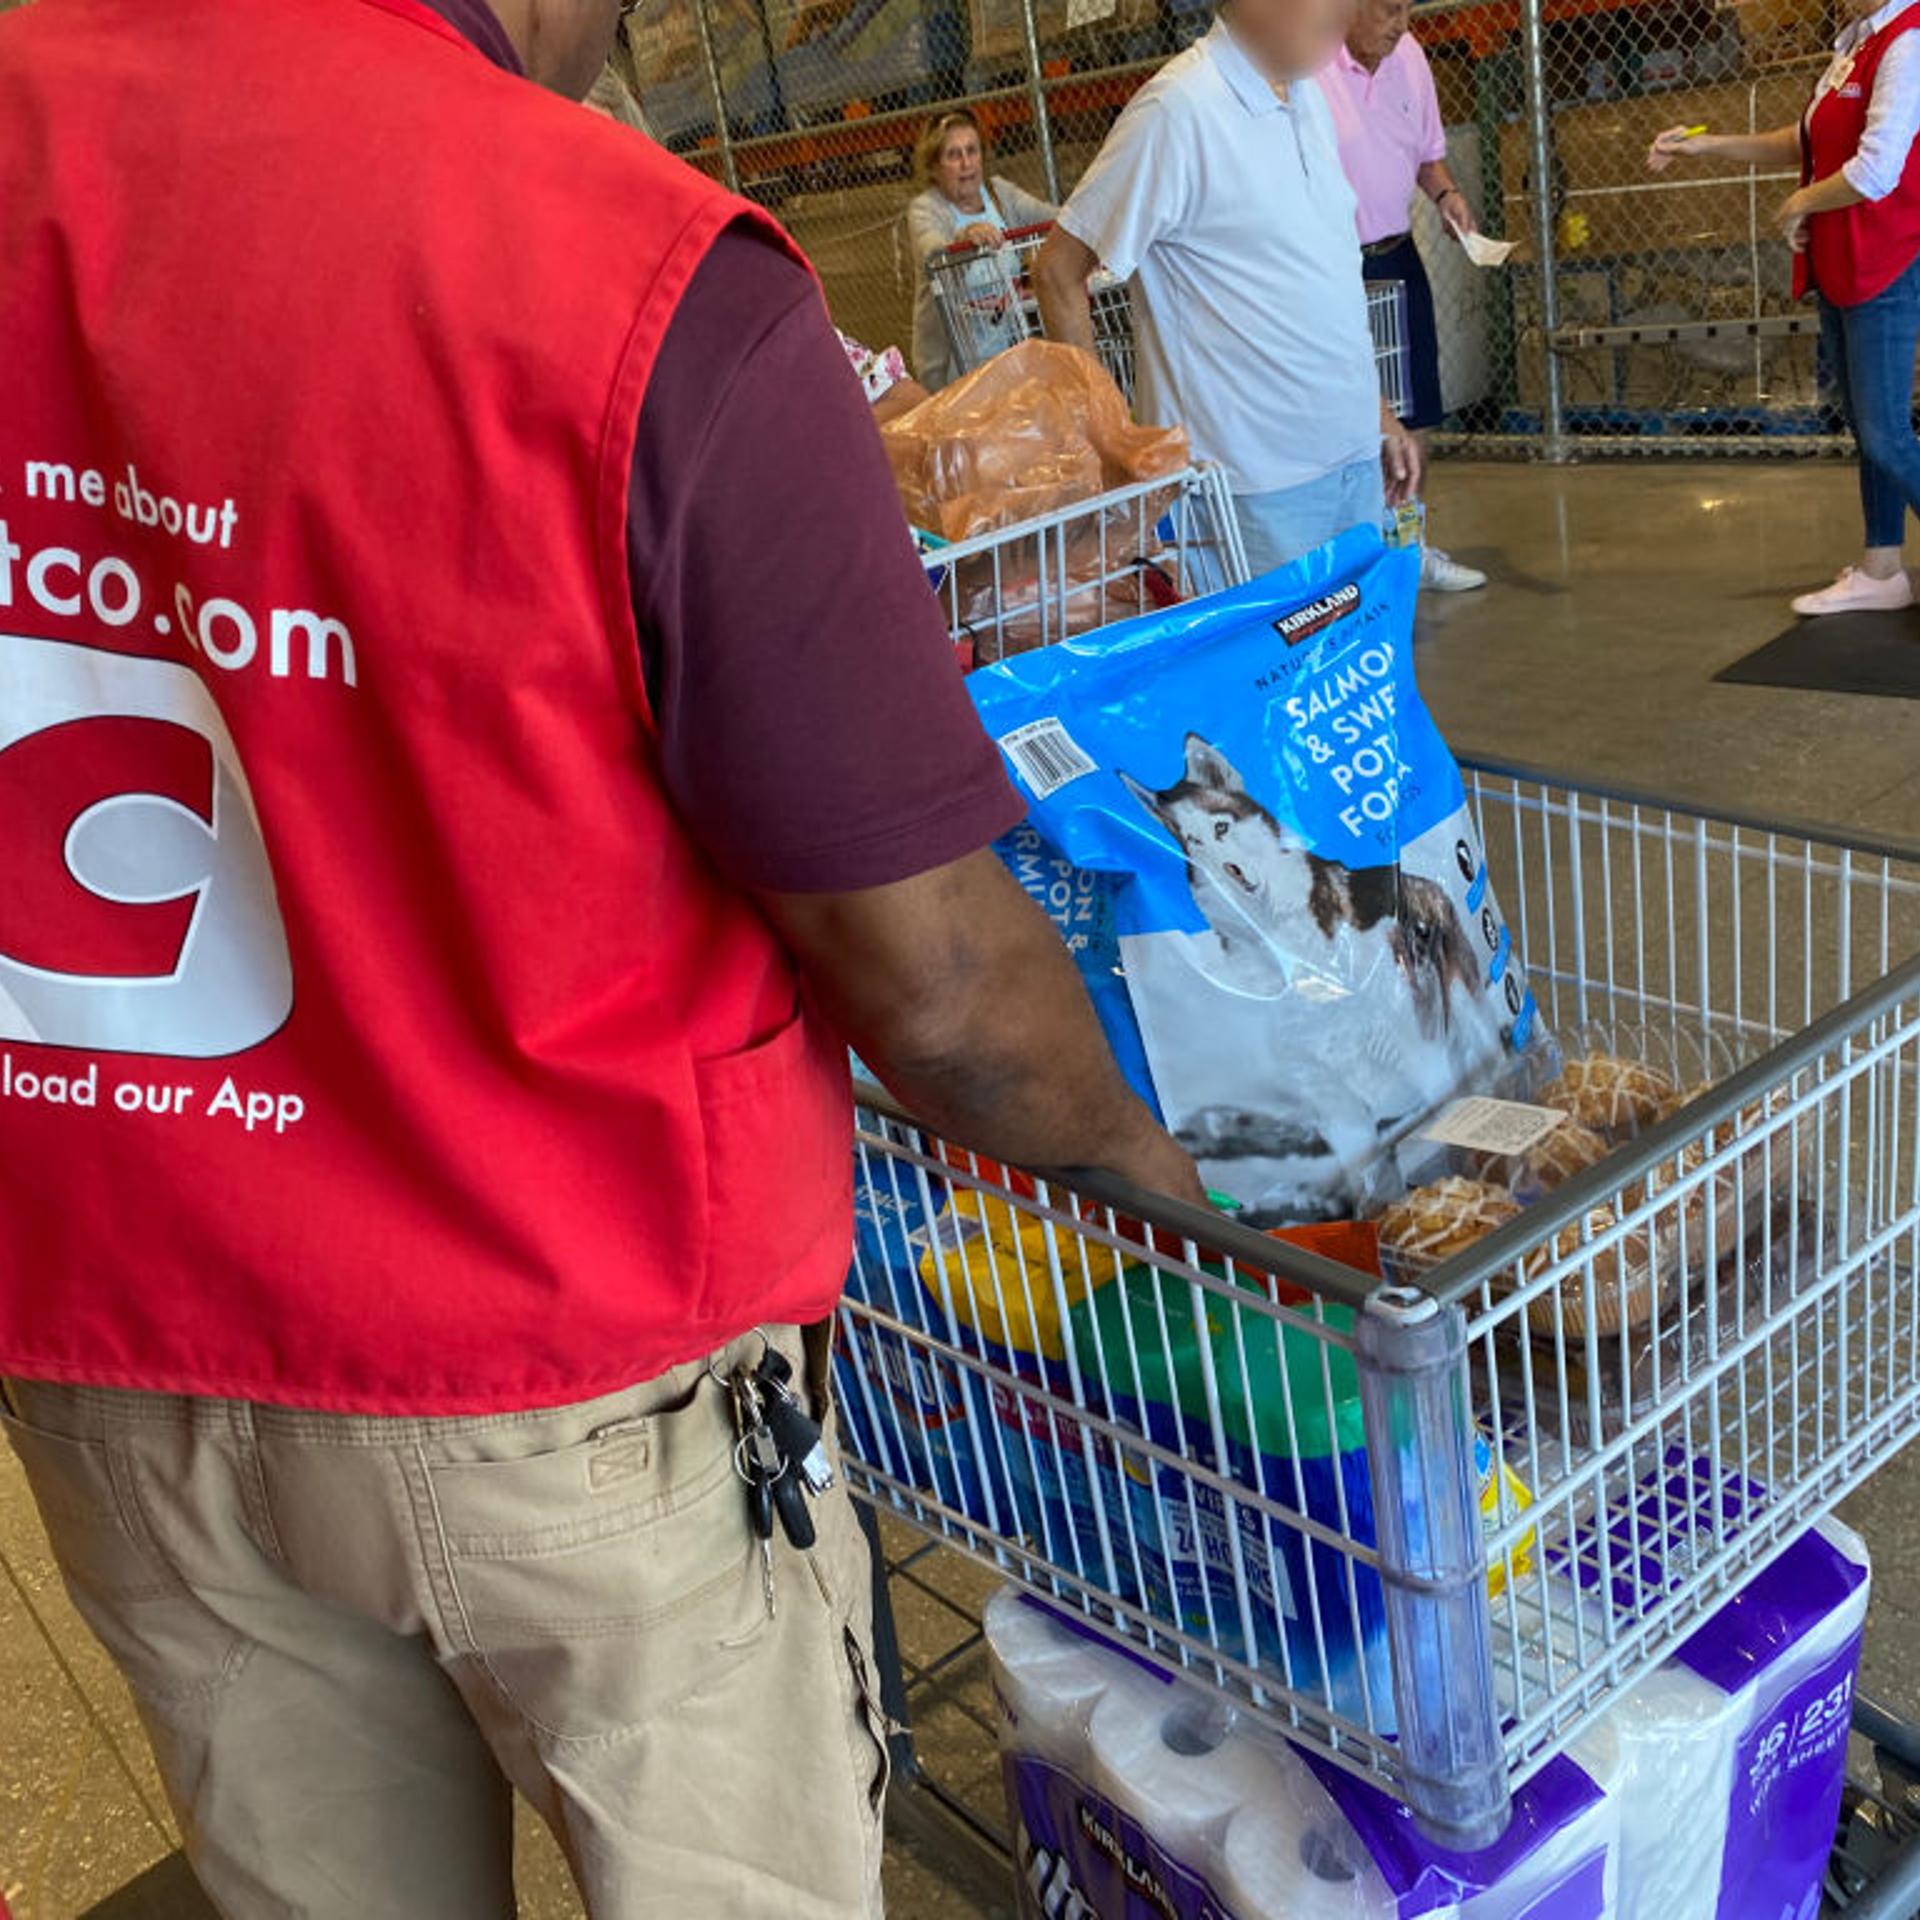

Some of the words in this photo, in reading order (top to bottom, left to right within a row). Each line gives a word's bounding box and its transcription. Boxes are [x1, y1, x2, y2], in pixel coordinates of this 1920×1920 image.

[25, 461, 105, 505] me
[114, 464, 238, 548] about
[1276, 584, 1358, 634] KIRKLAND
[1306, 734, 1335, 763] &
[1050, 859, 1073, 927] POT
[3, 1054, 97, 1107] load
[114, 1083, 193, 1114] our
[206, 1075, 304, 1133] App
